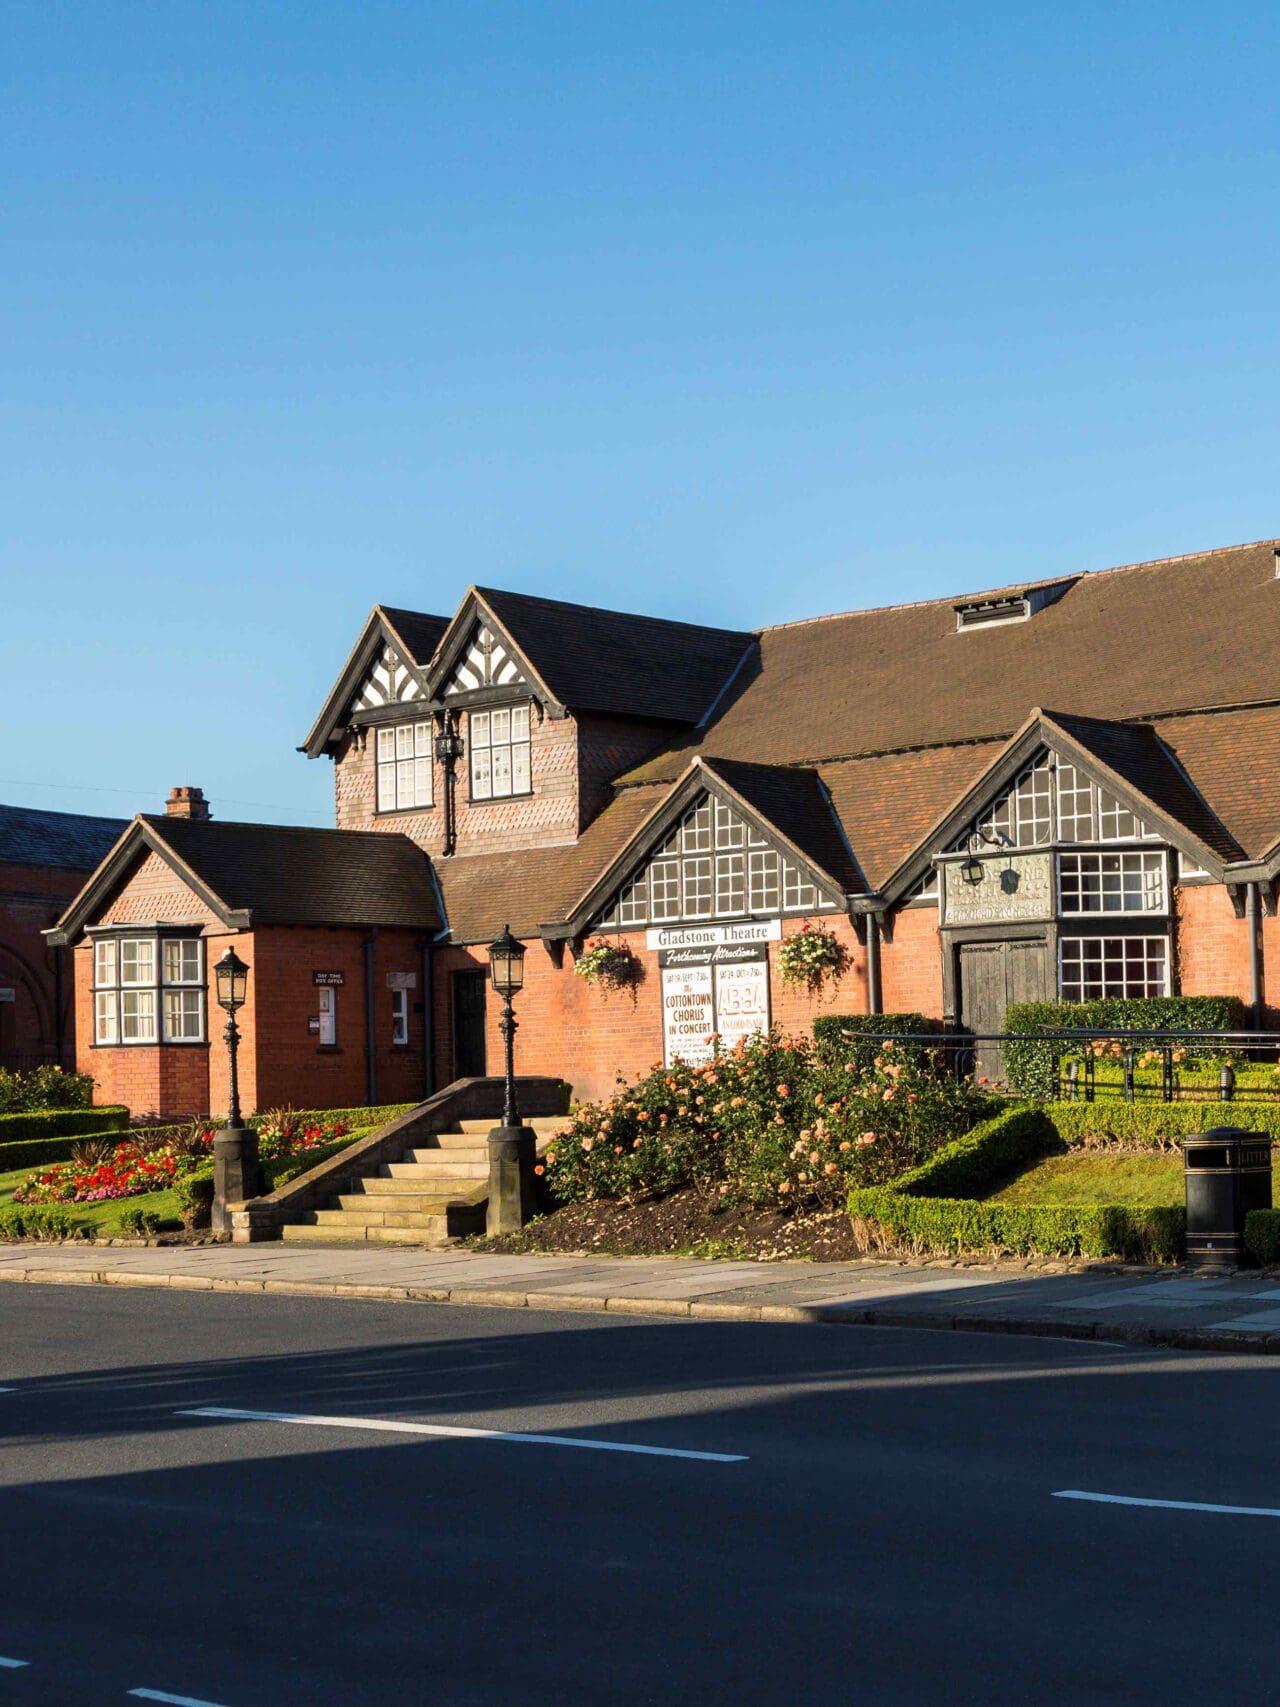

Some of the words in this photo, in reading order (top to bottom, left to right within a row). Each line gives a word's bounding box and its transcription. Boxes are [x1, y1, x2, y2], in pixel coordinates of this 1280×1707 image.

[658, 929, 716, 946] Gladstone
[721, 926, 768, 940] Theatre
[712, 944, 758, 960] Attractions
[666, 993, 712, 1008] COTTONTOWN
[673, 1009, 705, 1022] CHORUS
[669, 1026, 676, 1035] IN
[679, 1023, 711, 1034] CONCERT
